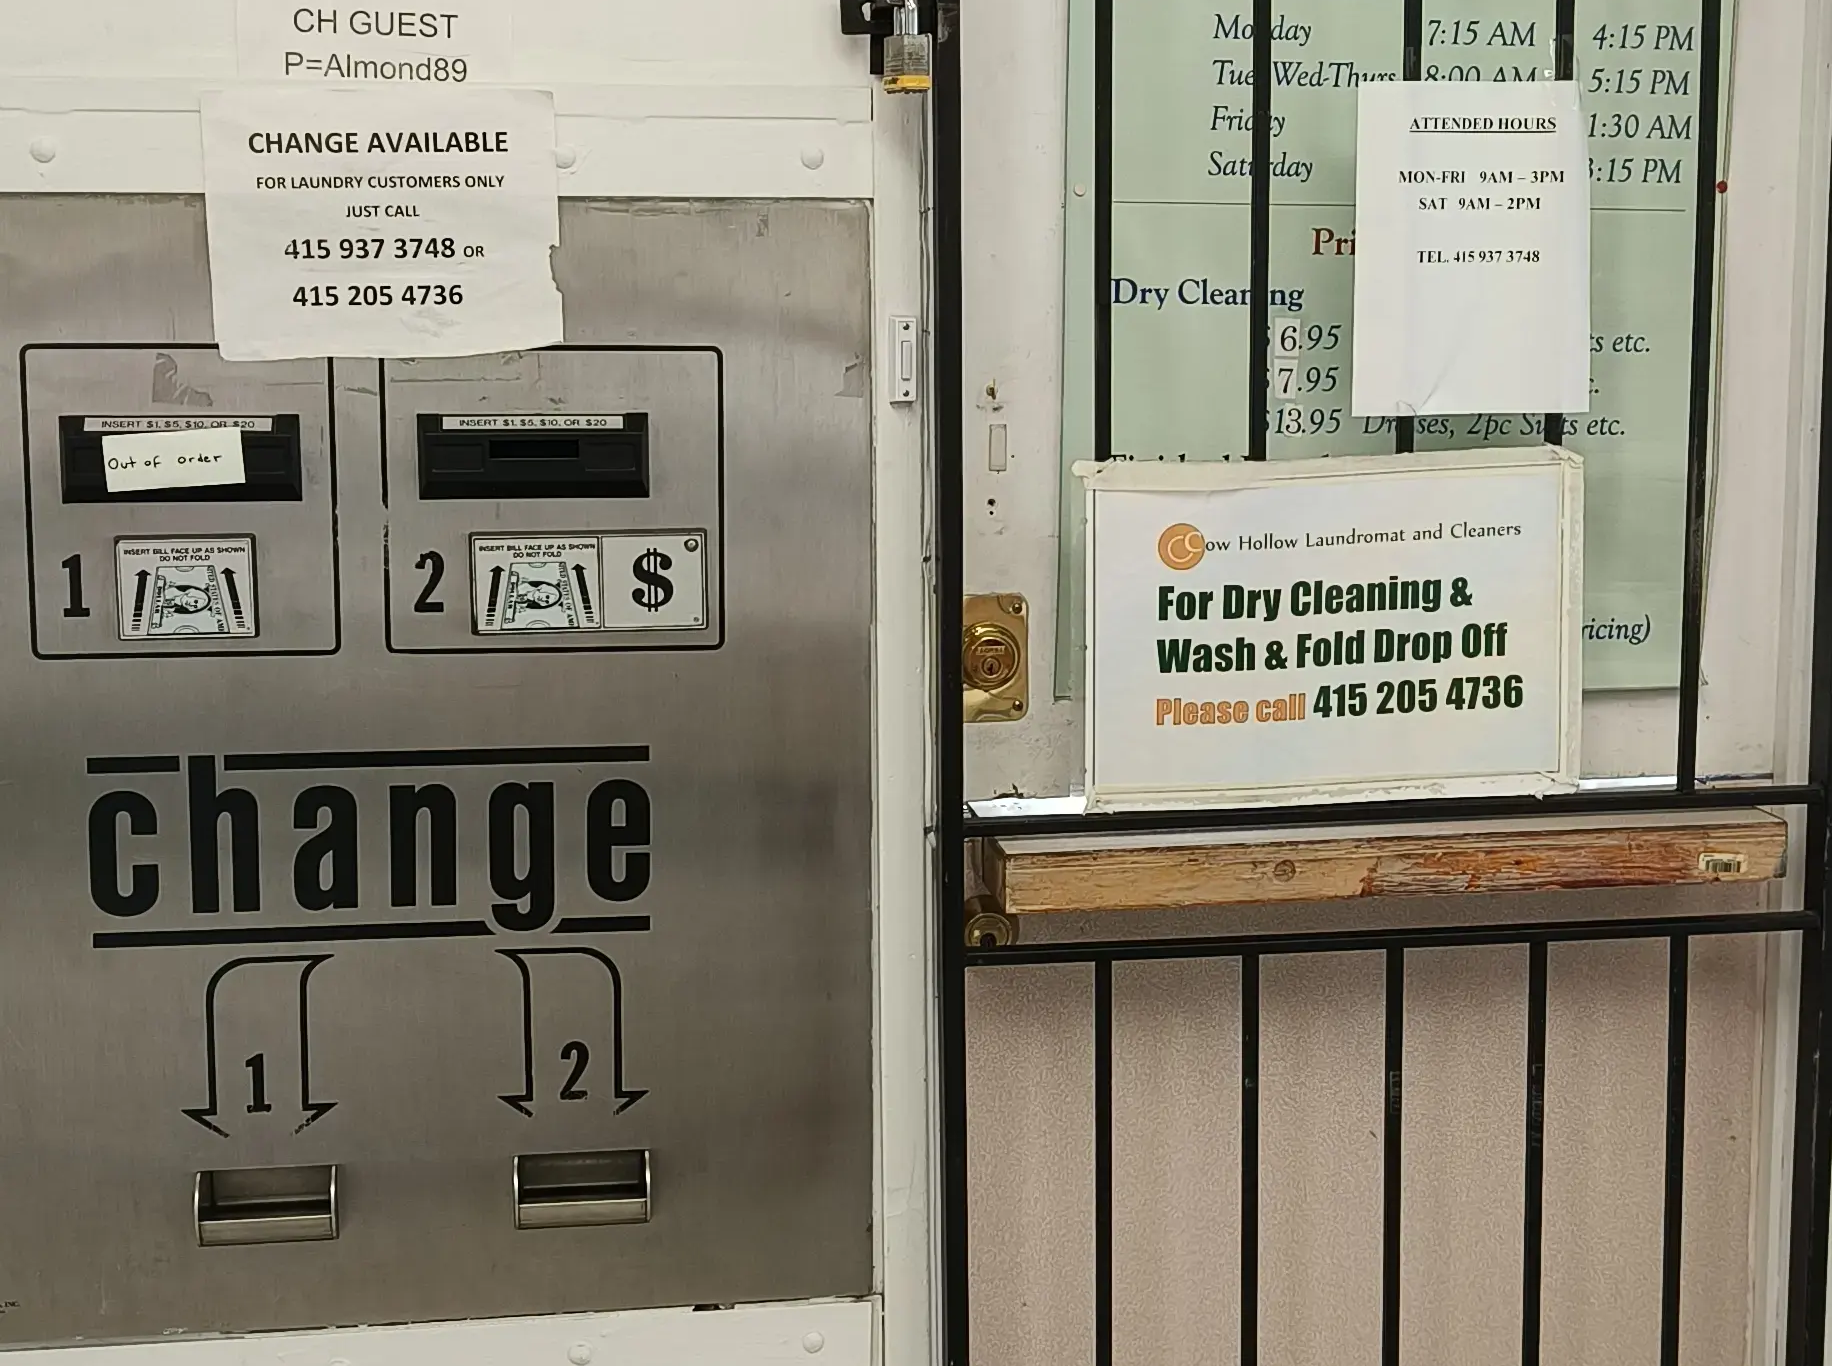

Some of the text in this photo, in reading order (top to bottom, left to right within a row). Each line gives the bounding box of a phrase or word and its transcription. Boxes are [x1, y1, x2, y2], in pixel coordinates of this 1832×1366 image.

[293, 8, 459, 39] CH GUEST
[1213, 13, 1695, 52] Moday 7:15 AM 4:15 PM
[285, 51, 468, 83] P=Almond89
[1587, 68, 1643, 94] 5:15
[1649, 69, 1691, 96] PM
[1408, 116, 1557, 131] ATTENDED HOURS
[1645, 113, 1693, 141] AM
[248, 131, 509, 154] CHANGE AVAILABLE
[256, 175, 505, 190] FOR LAUNDRY CUSTOMERS ONLY
[1398, 170, 1565, 185] MON-FRI 9AM 3PM
[1641, 158, 1682, 185] PM
[346, 205, 420, 218] JUST CALL
[1418, 196, 1541, 211] SAT 9AM 2PM
[284, 237, 485, 260] 415 937 3748 OR
[1417, 249, 1541, 264] TEL. 415 937 3748
[293, 284, 464, 307] 415 205 4736
[1112, 278, 1170, 311] Dry
[1612, 333, 1652, 354] etc.
[101, 420, 142, 429] INSERT
[211, 420, 227, 428] OR
[232, 420, 256, 429] $20
[459, 419, 498, 427] INSERT
[563, 419, 580, 427] OR
[585, 418, 608, 428] $20
[1467, 415, 1513, 442] 2pc
[1586, 417, 1626, 437] etc.
[107, 453, 223, 470] Out of order
[170, 547, 189, 555] FACE
[216, 546, 246, 554] SHOWN
[1239, 521, 1523, 552] Hollow Laundromat and Cleaners
[60, 553, 91, 618] 1
[414, 550, 445, 613] 2
[631, 547, 675, 613] $
[1157, 575, 1474, 622] For Dry Cleaning &
[1582, 614, 1651, 646] ricing)
[1156, 622, 1509, 675] Wash & Fold Drop Off
[1156, 674, 1525, 727] Please call 415 205 4736
[87, 754, 651, 932] change
[245, 1052, 272, 1113] 1
[558, 1040, 590, 1101] 2
